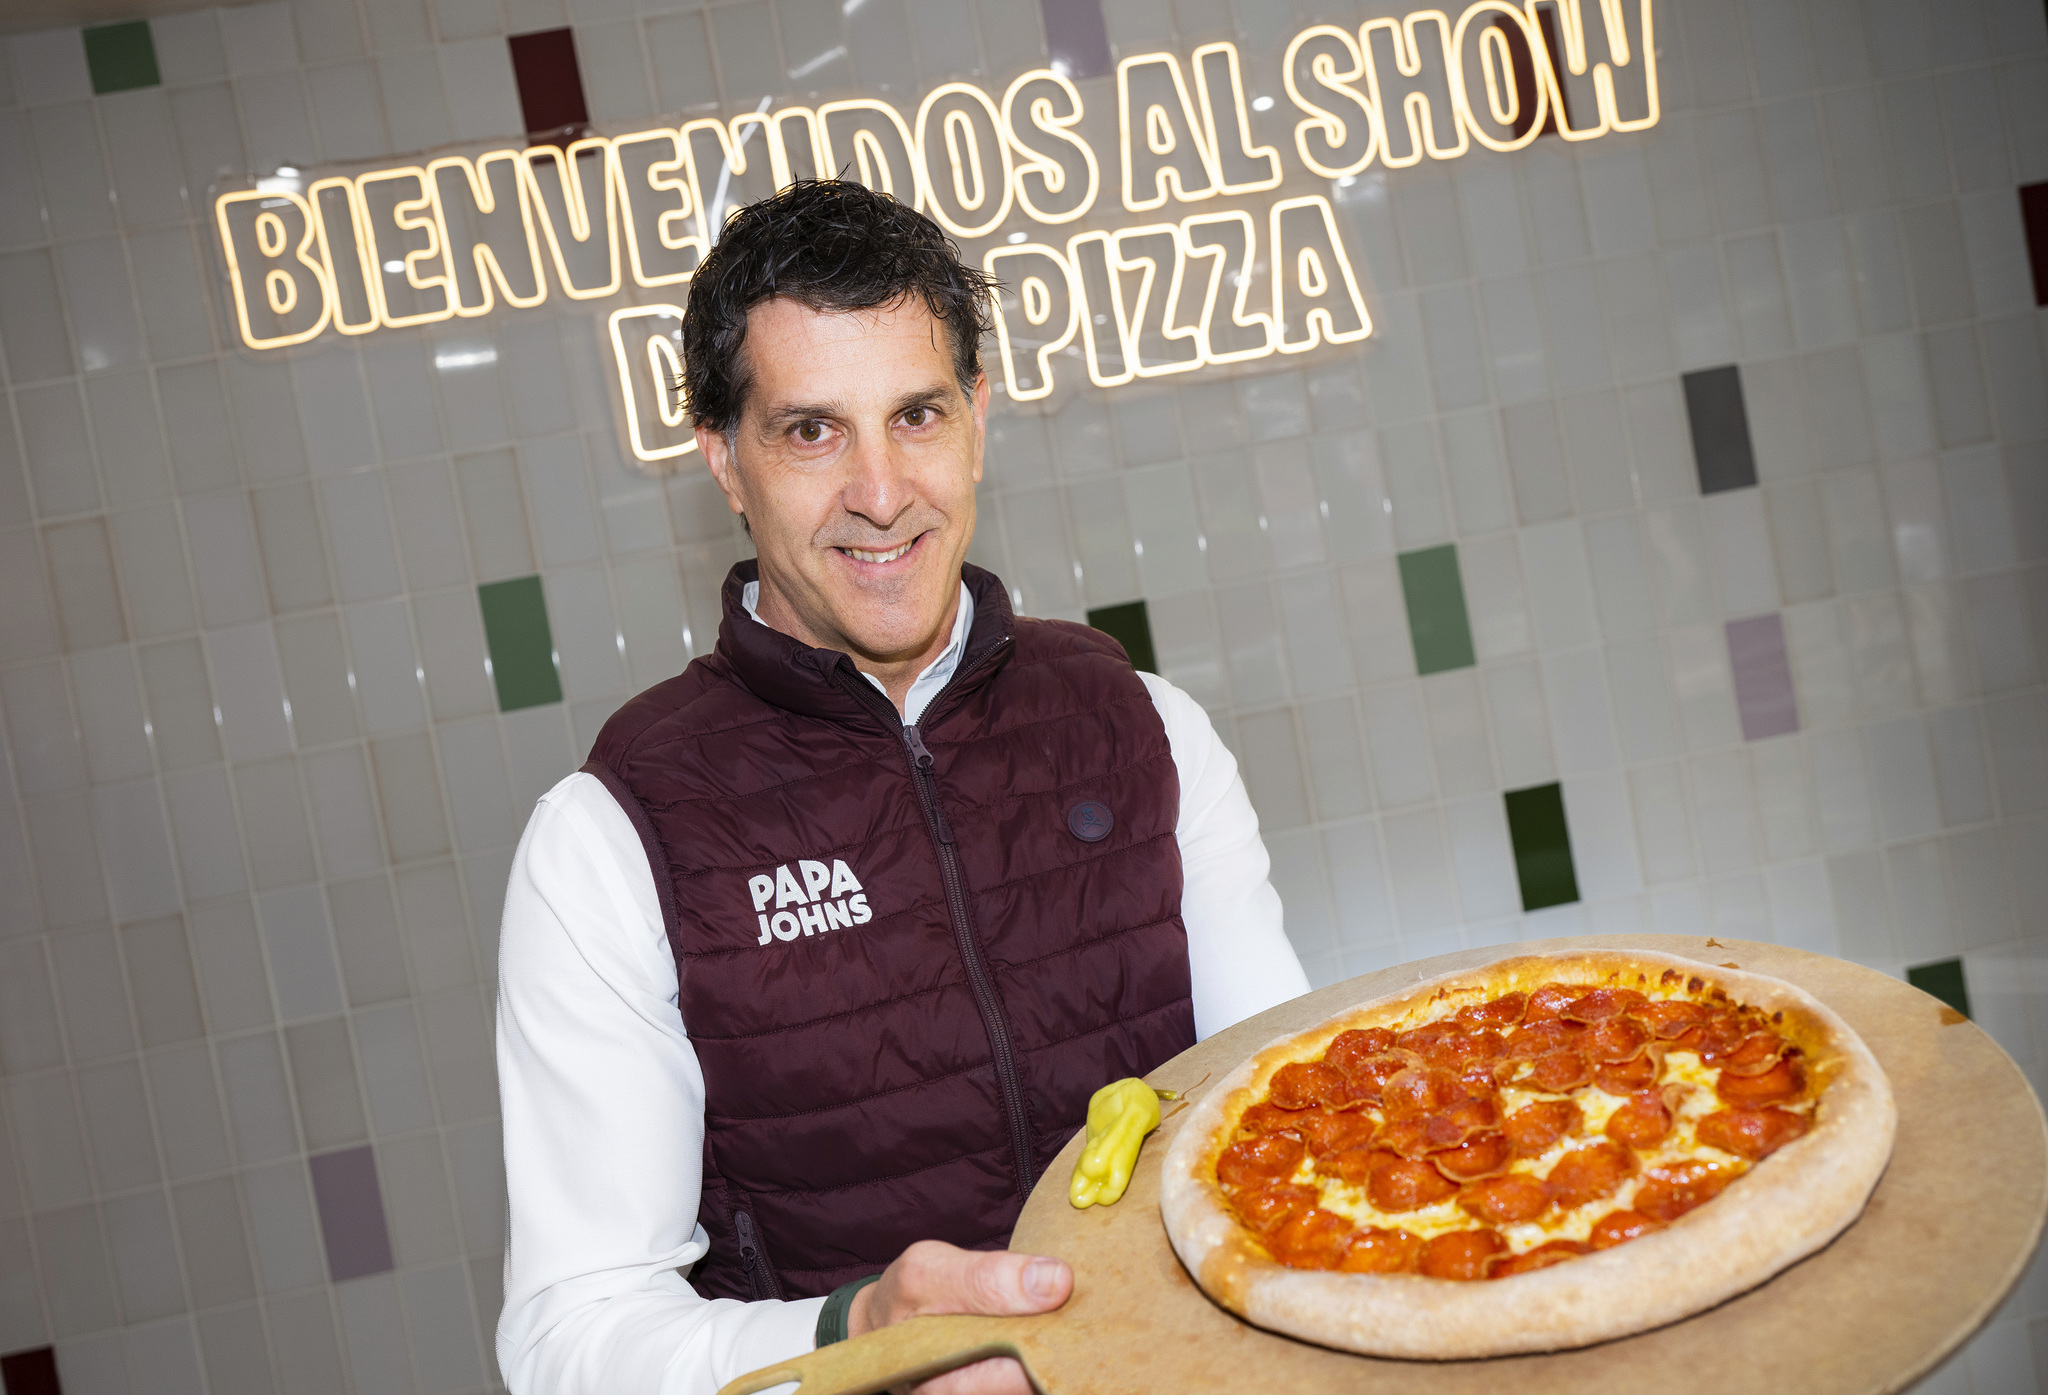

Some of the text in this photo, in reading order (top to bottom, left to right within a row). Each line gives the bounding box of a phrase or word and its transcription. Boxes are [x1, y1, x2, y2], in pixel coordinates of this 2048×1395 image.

[1117, 41, 1281, 212] AL
[1283, 0, 1660, 178] SHOW
[983, 195, 1373, 401] PIZZA
[748, 859, 864, 912] PAPA
[757, 893, 873, 946] JOHNS
